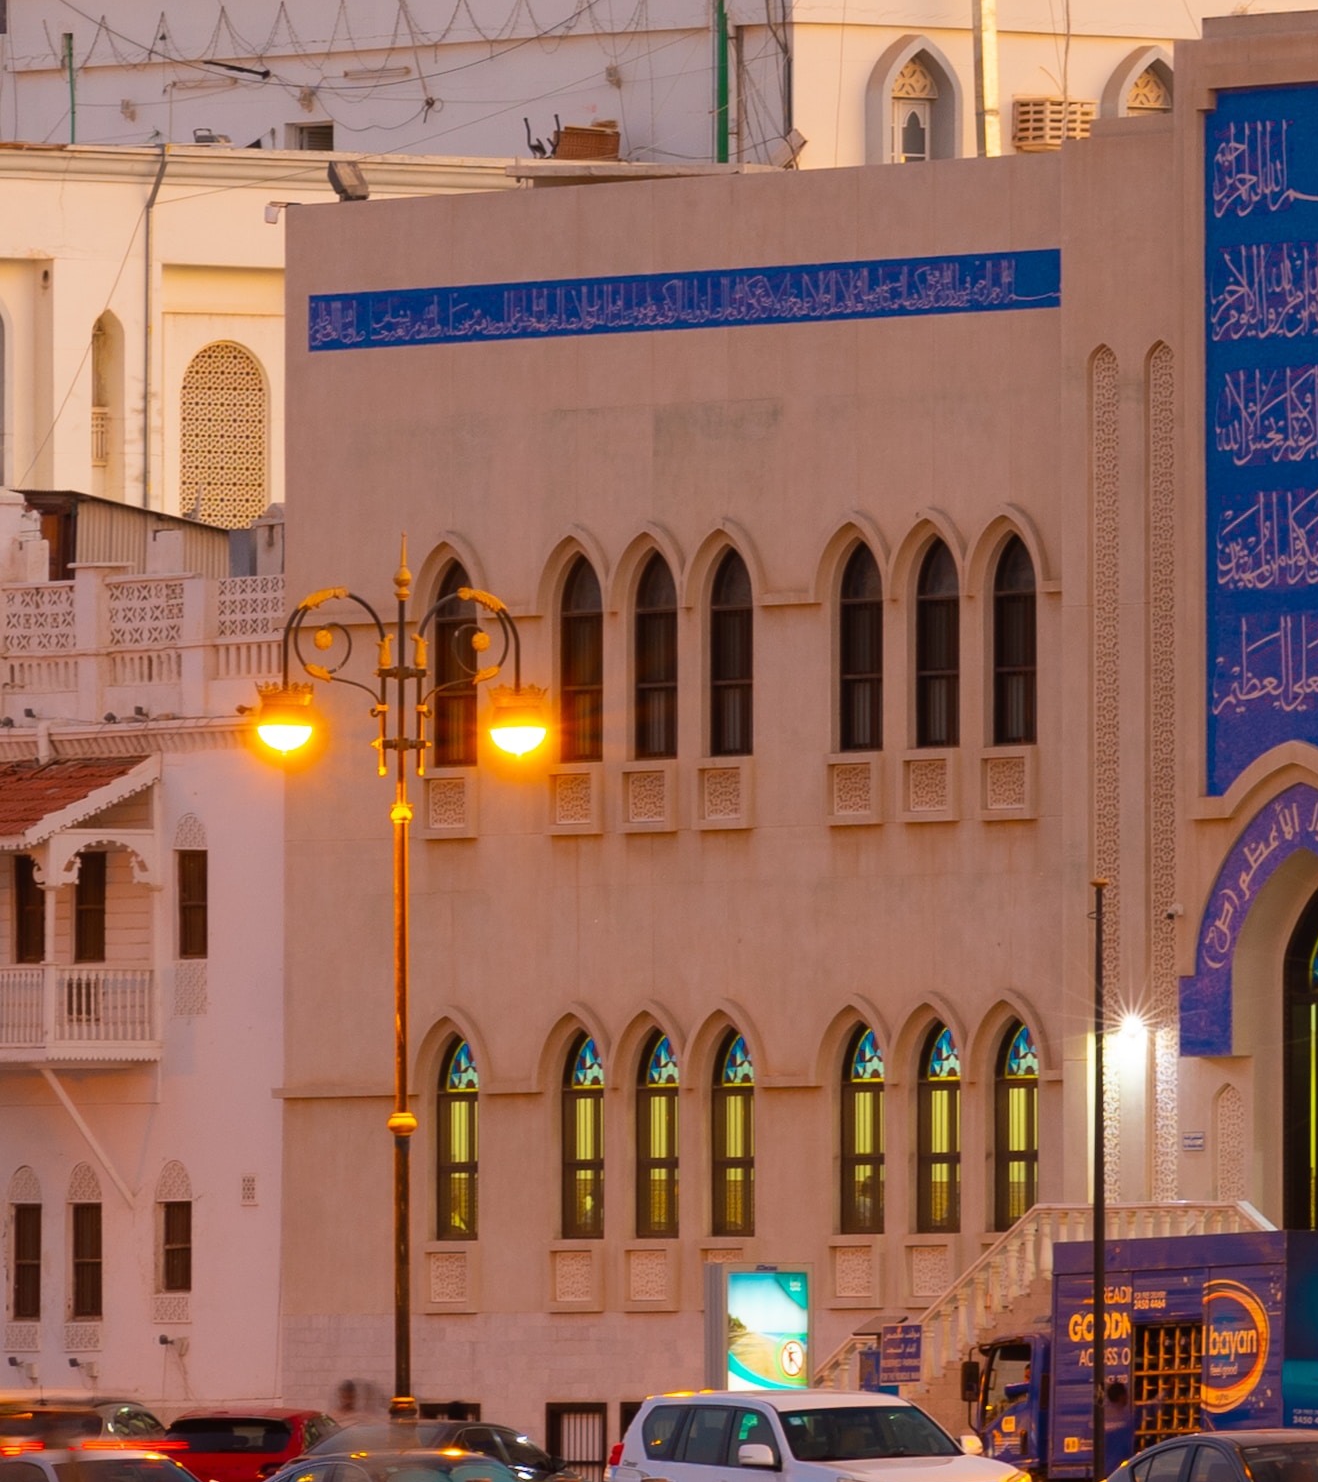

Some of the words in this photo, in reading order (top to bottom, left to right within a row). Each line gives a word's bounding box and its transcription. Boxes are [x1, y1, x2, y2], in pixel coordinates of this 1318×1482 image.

[1212, 615, 1294, 715] العظيم
[1239, 802, 1299, 900] الأعظم
[1208, 1324, 1257, 1362] bayan
